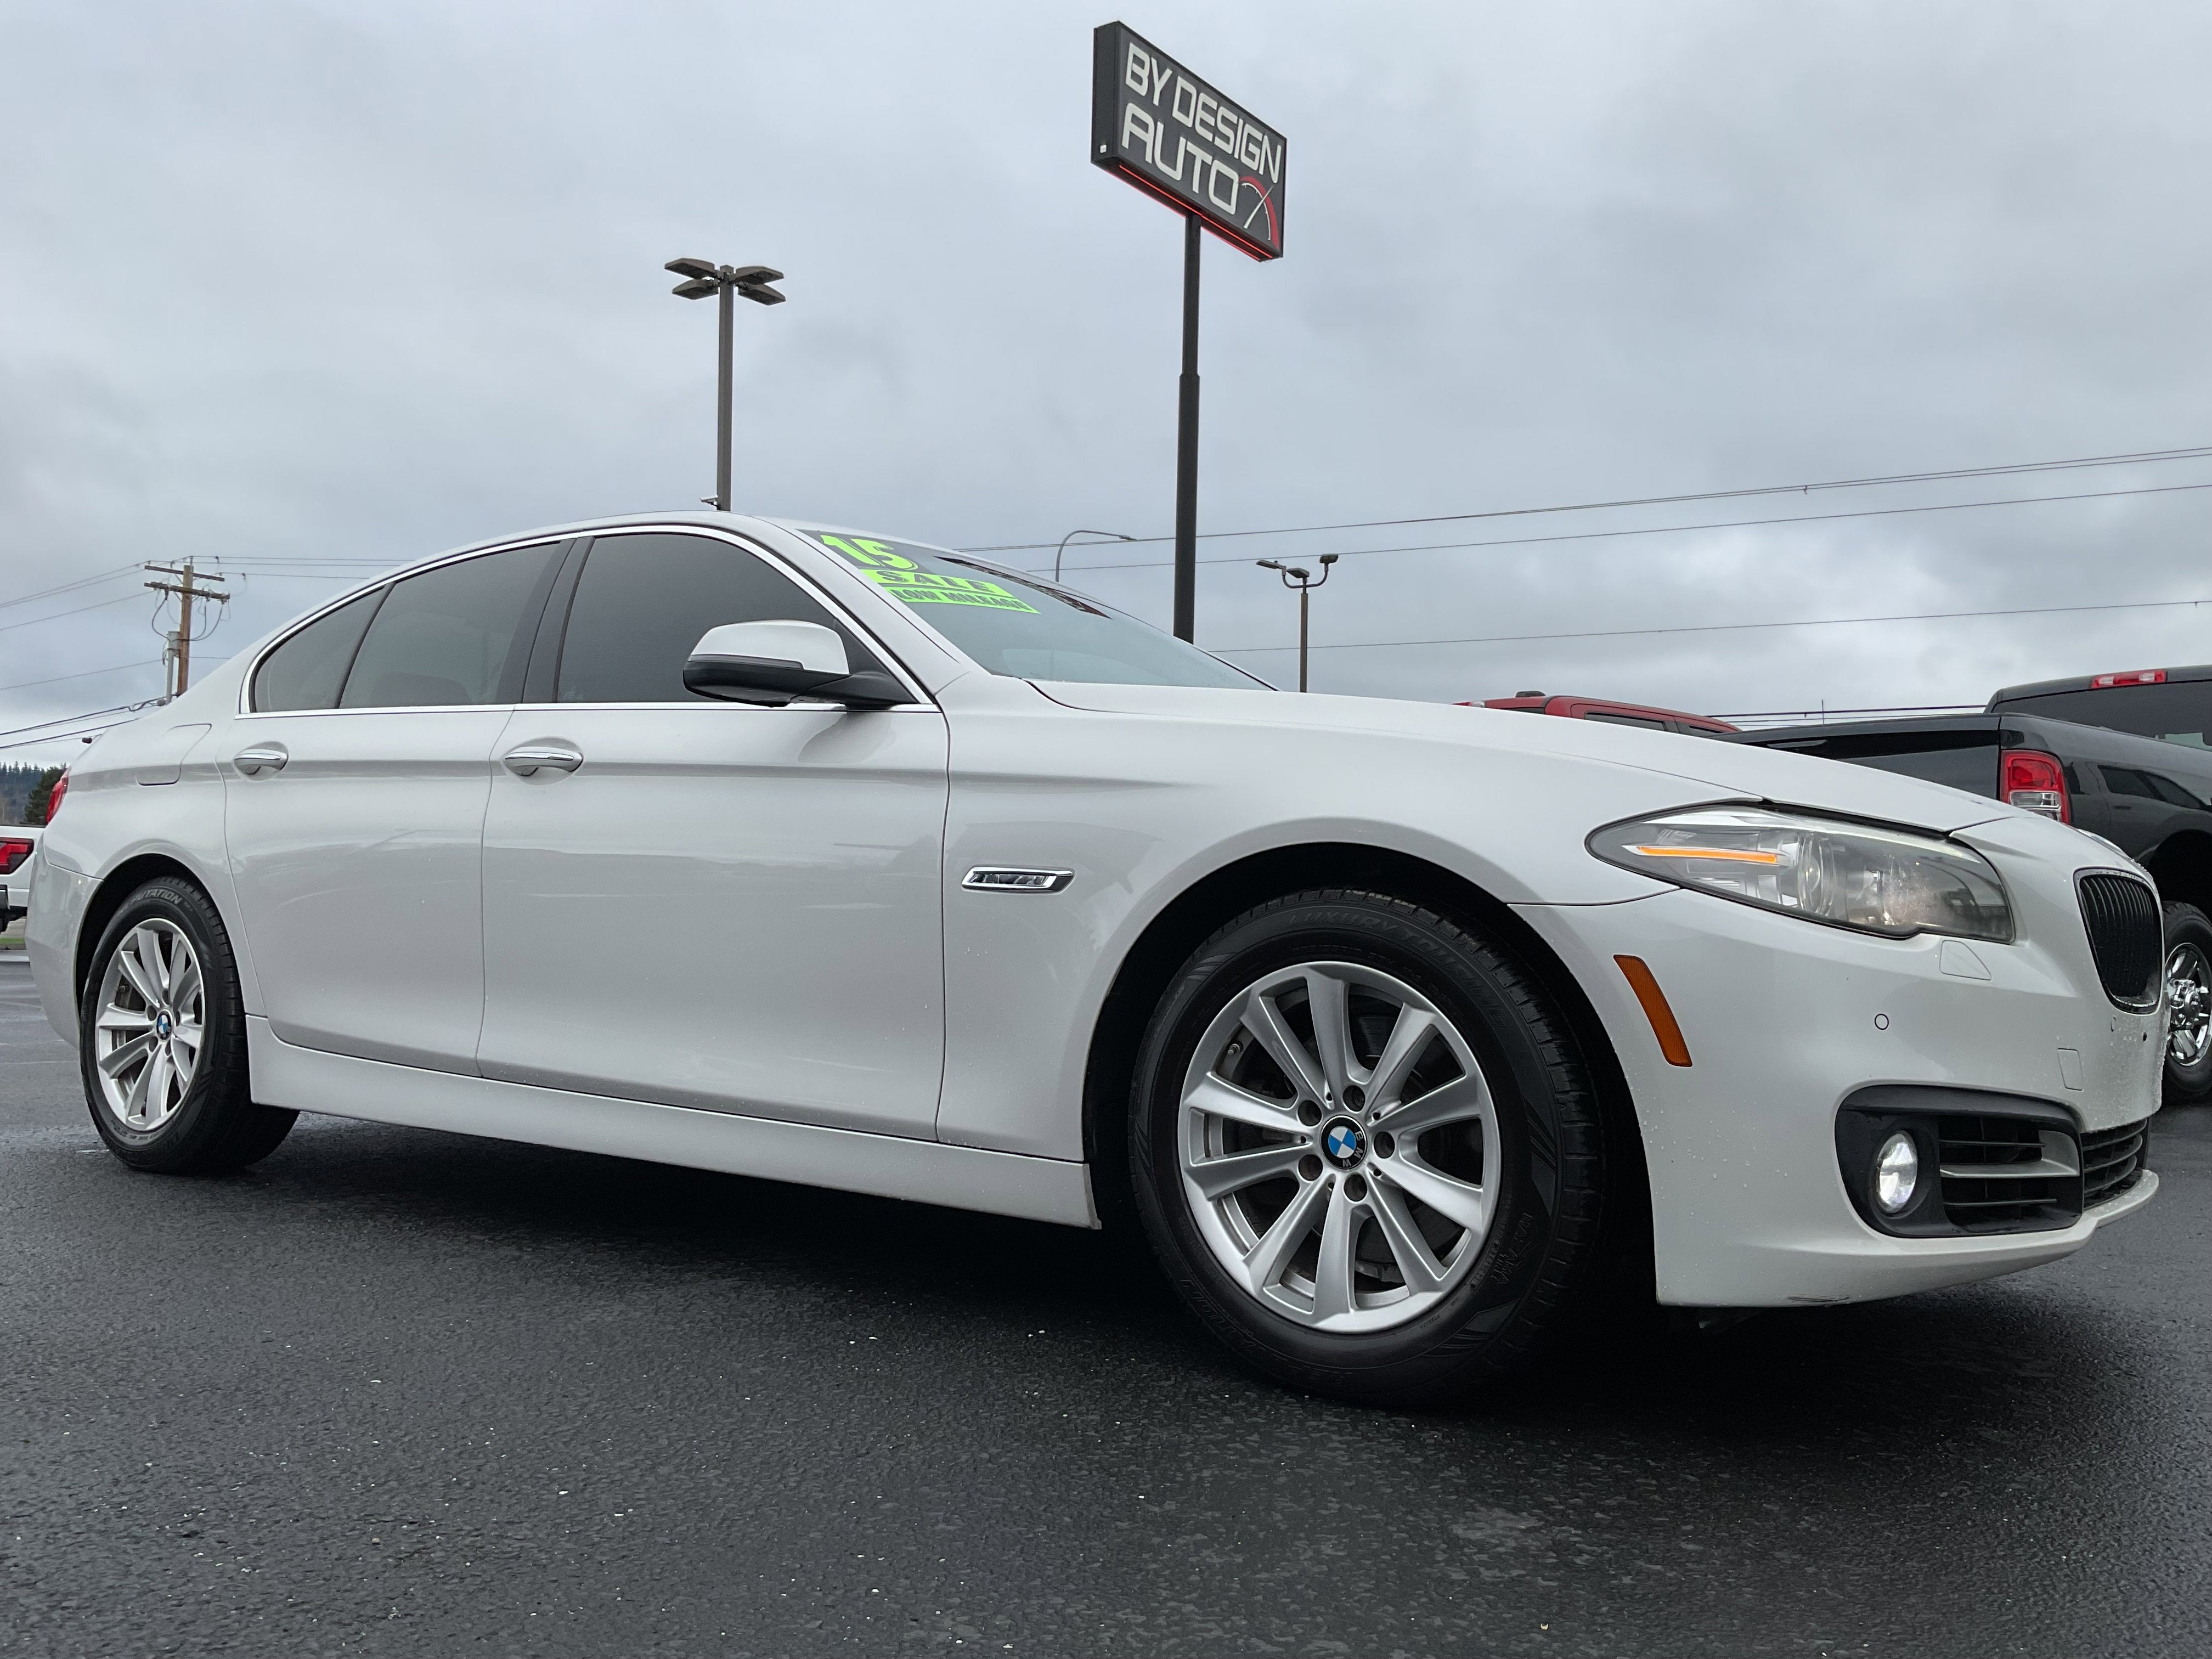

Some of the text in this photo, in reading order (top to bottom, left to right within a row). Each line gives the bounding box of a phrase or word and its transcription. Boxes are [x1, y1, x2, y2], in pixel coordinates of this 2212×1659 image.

[1125, 42, 1282, 184] BY DESIGN
[1122, 103, 1239, 215] AUTO
[820, 535, 918, 571] 15
[876, 571, 994, 593] SALE
[890, 589, 941, 601] LOW
[1285, 911, 1400, 933] LUXURY
[1400, 929, 1510, 1028] TOURING
[1342, 1130, 1364, 1167] BMW
